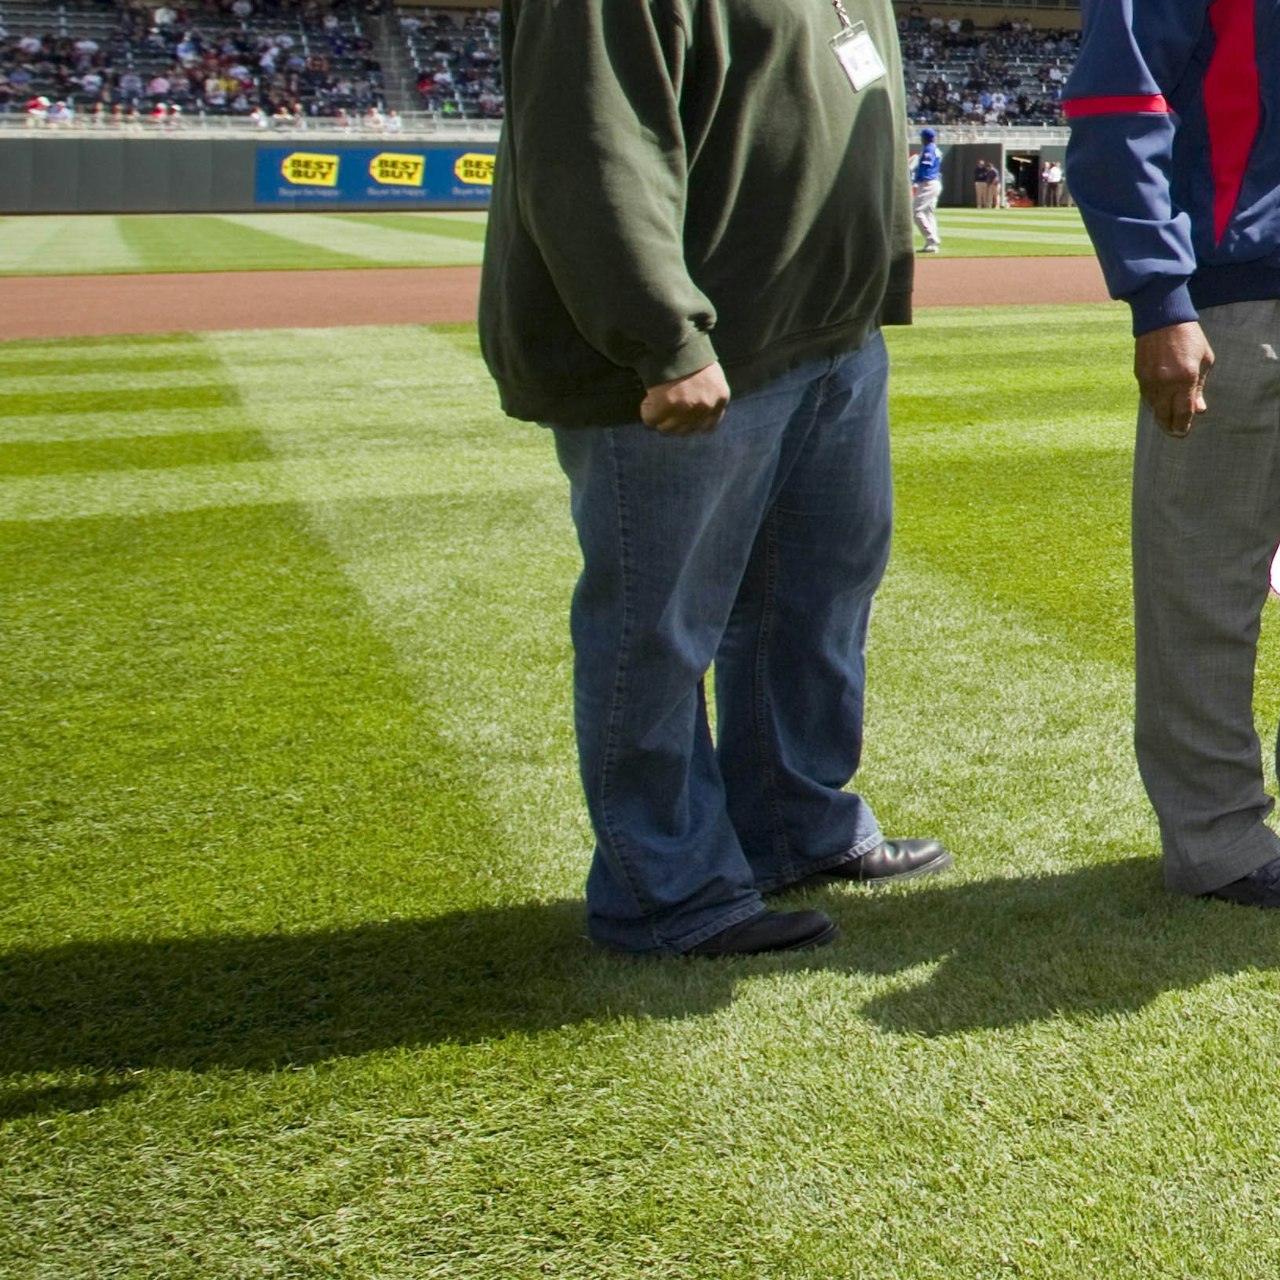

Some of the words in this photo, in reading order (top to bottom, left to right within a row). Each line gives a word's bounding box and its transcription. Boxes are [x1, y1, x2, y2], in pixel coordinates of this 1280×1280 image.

[290, 158, 336, 171] BEST
[377, 158, 421, 170] BEST
[462, 158, 496, 170] BES
[290, 169, 330, 180] BUY
[378, 169, 416, 180] BUY
